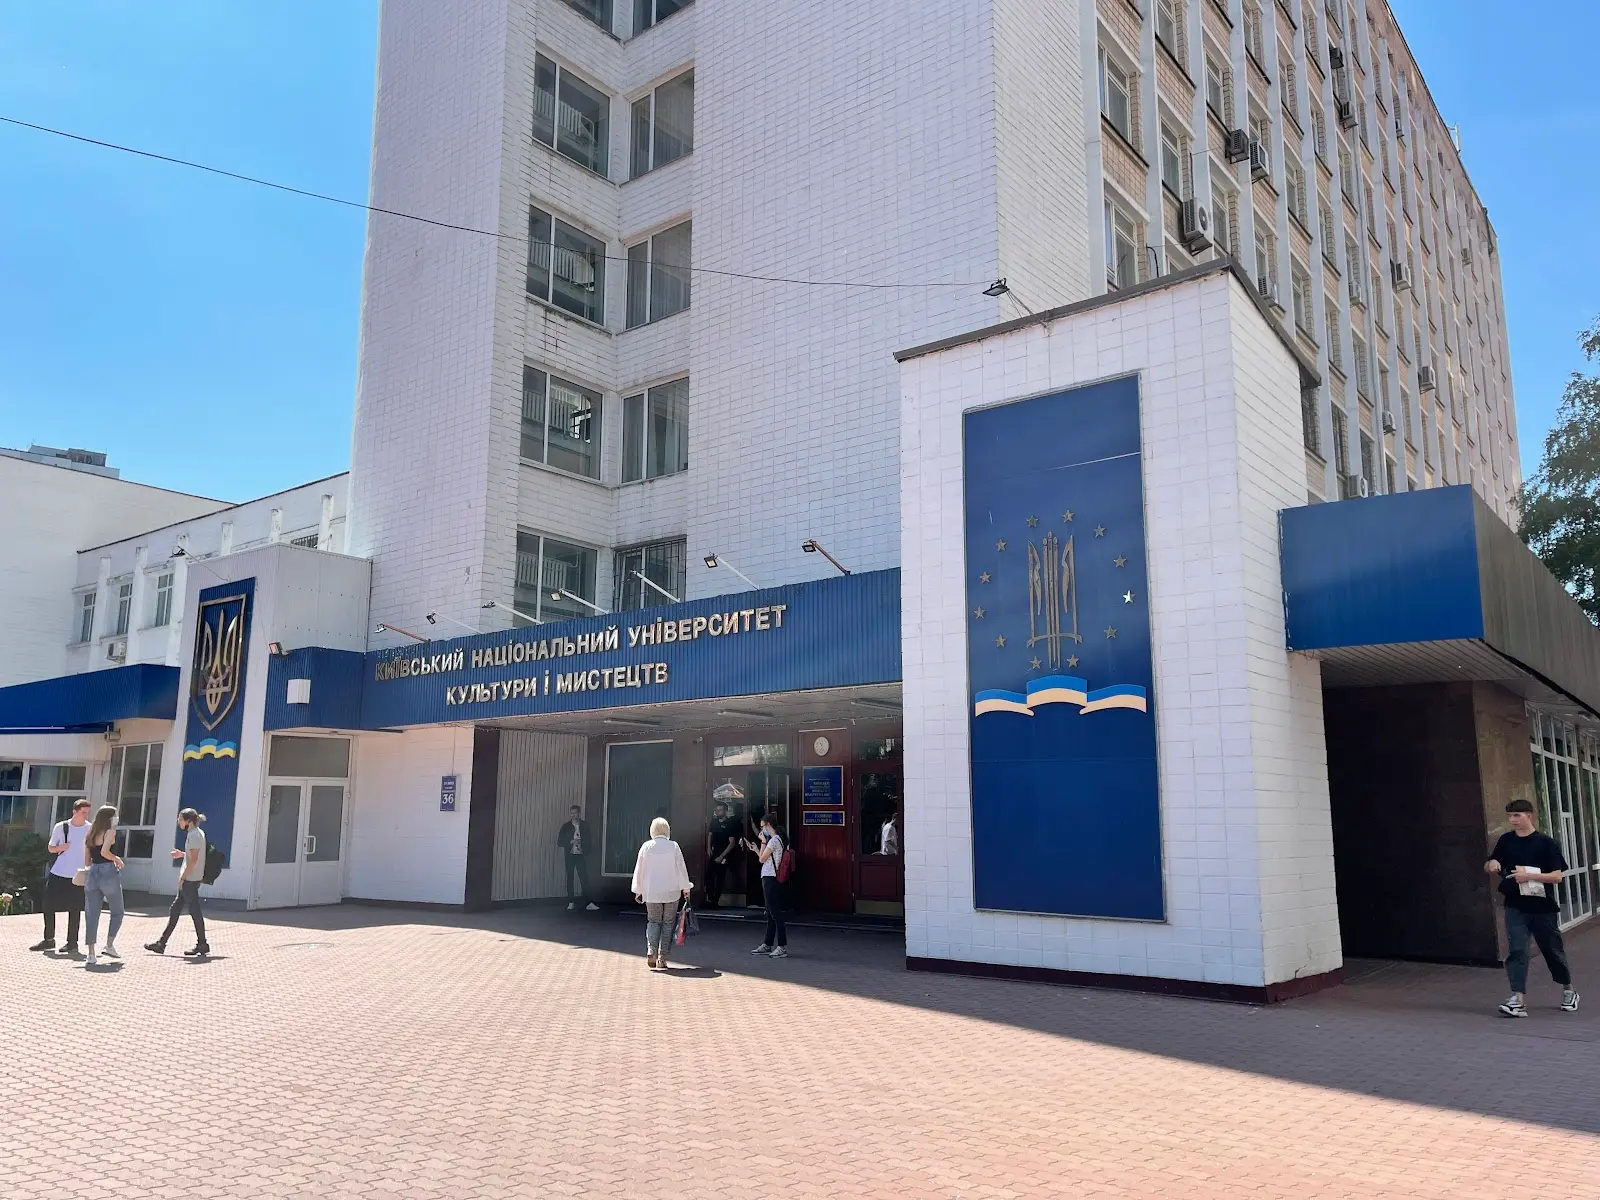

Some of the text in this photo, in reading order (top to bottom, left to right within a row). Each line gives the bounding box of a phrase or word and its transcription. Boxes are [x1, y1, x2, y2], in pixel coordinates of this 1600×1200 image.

[375, 648, 463, 681] КИЇВСЬКИЙ
[445, 677, 537, 706] КУЛЬТУРИ
[556, 662, 668, 694] МИСТЕЦТВ
[442, 793, 454, 805] 36
